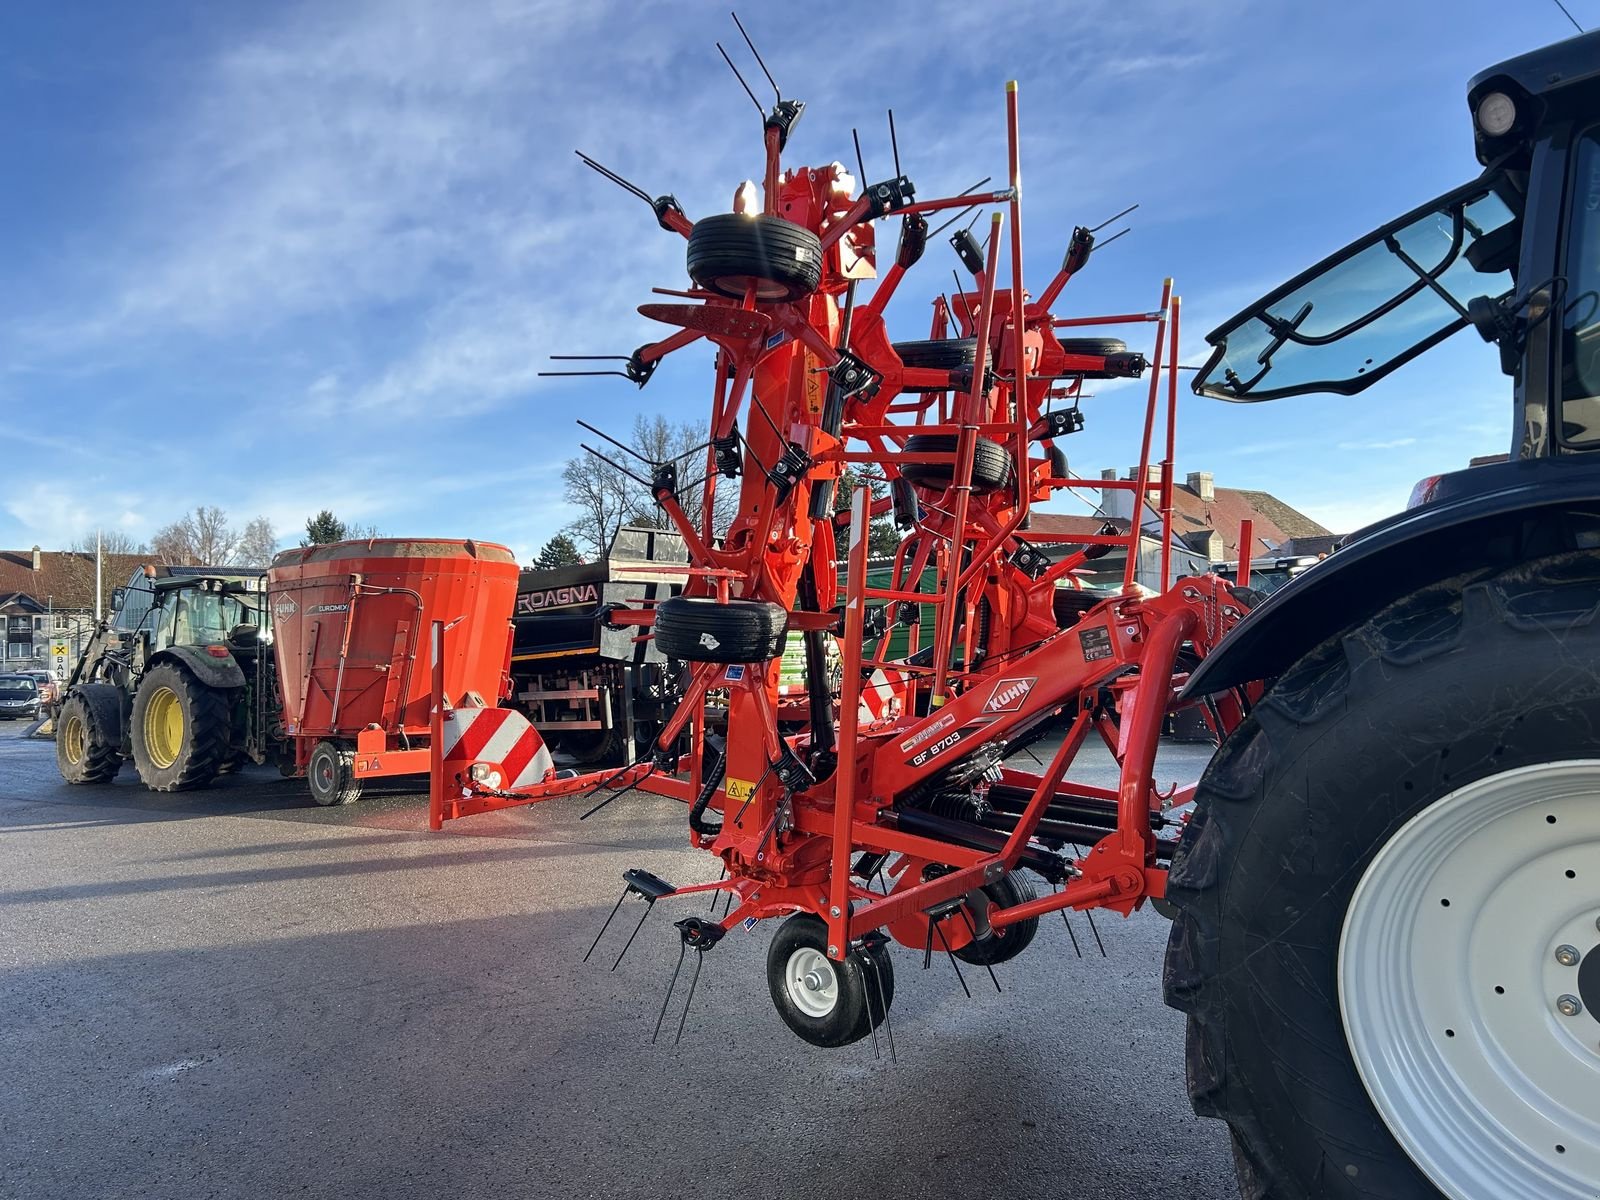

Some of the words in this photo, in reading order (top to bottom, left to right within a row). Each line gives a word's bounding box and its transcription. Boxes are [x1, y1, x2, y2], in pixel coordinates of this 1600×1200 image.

[318, 603, 348, 612] EUROMIX
[517, 584, 599, 613] ROAGNA
[56, 656, 64, 681] BAN
[989, 679, 1031, 711] KUHN
[912, 750, 928, 766] GF
[930, 731, 961, 755] 8703
